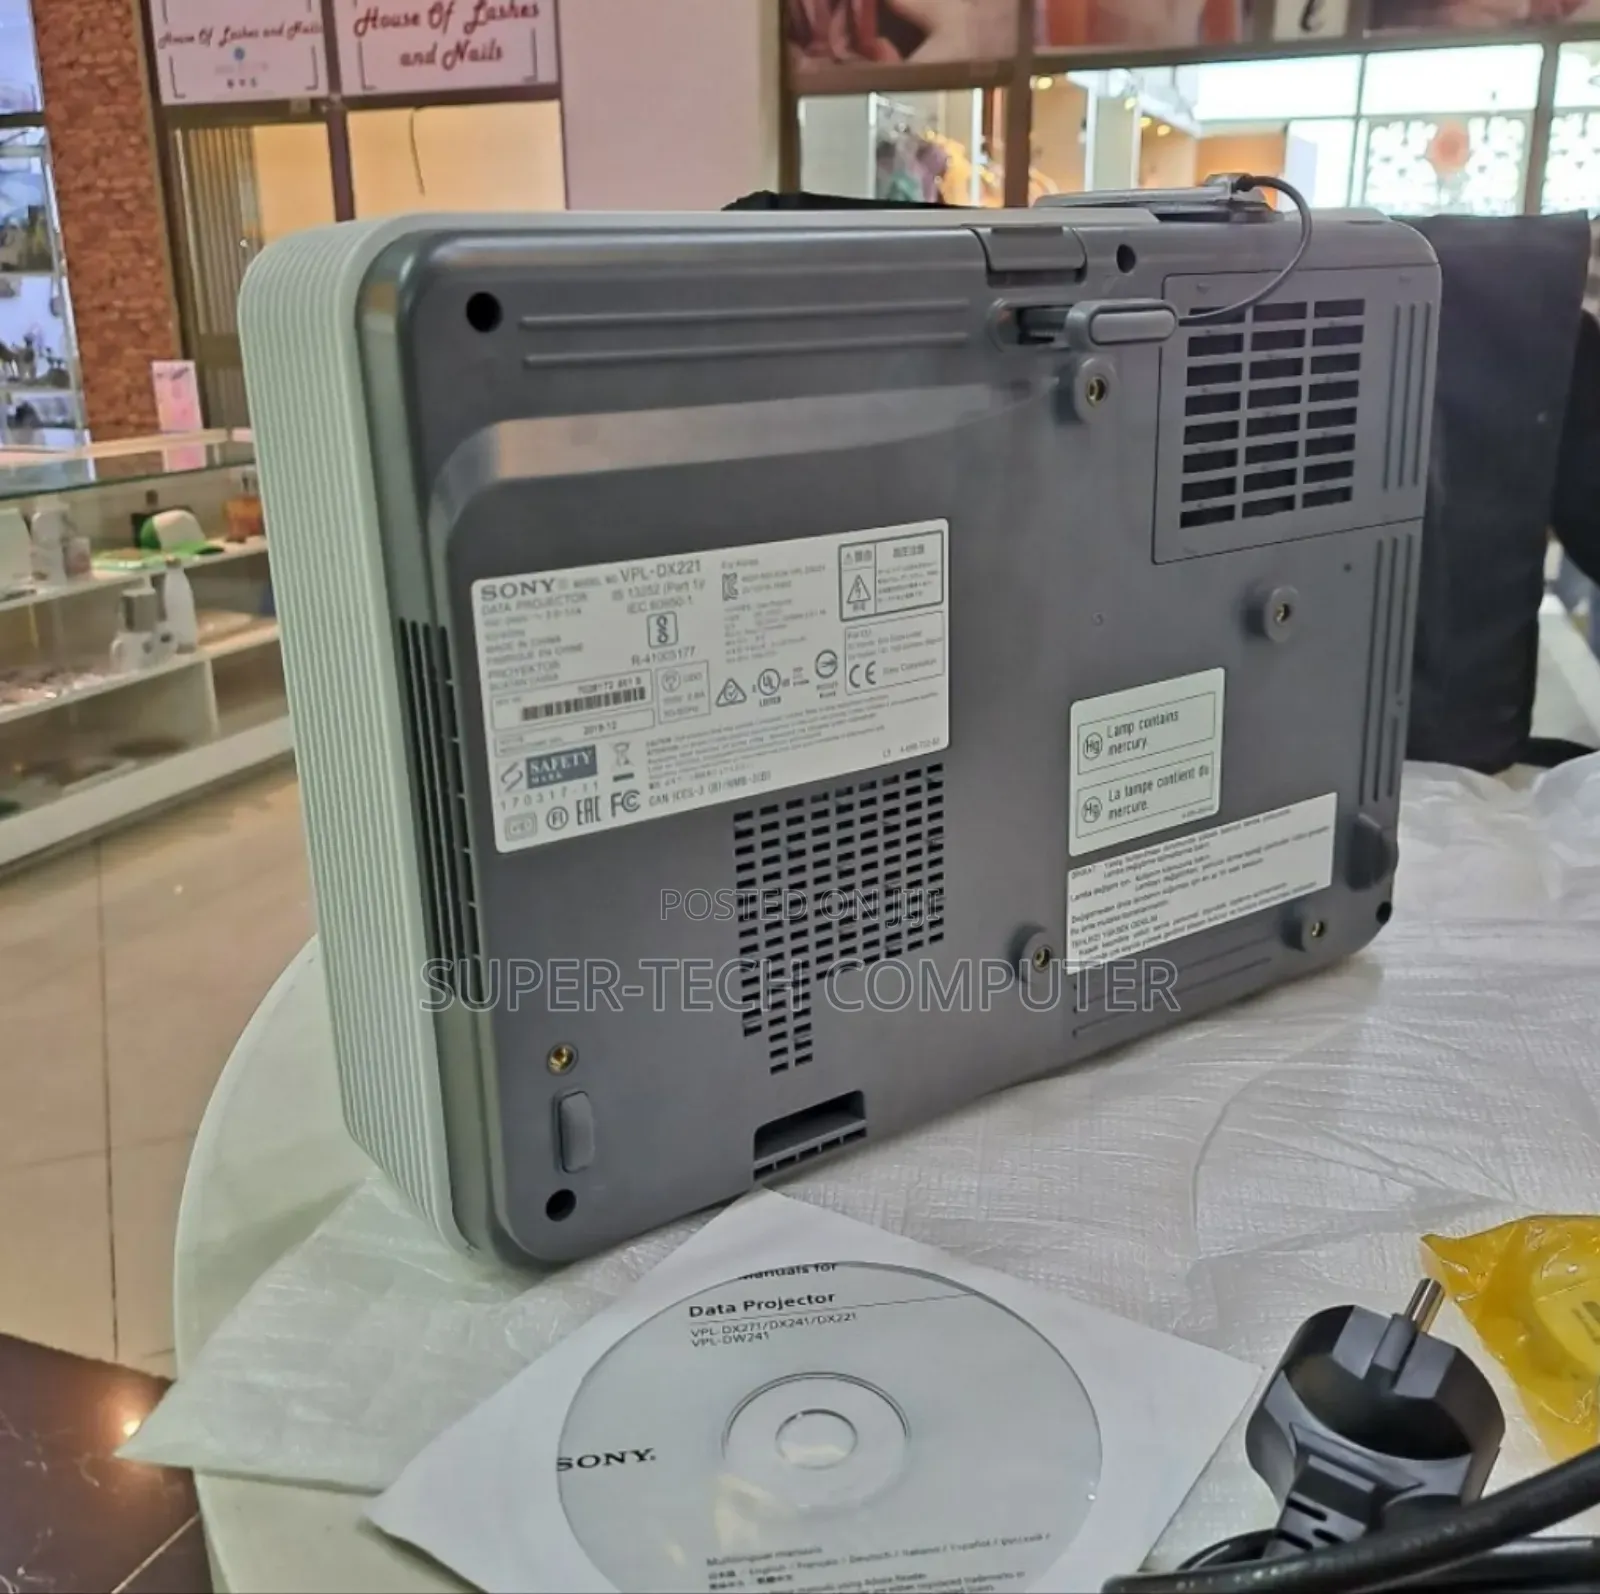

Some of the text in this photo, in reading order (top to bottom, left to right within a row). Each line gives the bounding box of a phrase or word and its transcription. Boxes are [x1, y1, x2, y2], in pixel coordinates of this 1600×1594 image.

[354, 0, 540, 37] House Of Lashes
[158, 31, 195, 49] House
[218, 25, 259, 47] Lashes
[263, 21, 285, 38] and
[400, 38, 503, 71] and Nails
[480, 578, 554, 601] SONY
[620, 559, 701, 583] VPL-DX221
[481, 602, 511, 616] DATA
[1107, 710, 1179, 738] Lamp contains
[1108, 737, 1148, 756] mercury
[529, 750, 593, 775] SAFETY
[1108, 789, 1120, 802] La
[1125, 779, 1153, 797] lampe
[1157, 767, 1195, 788] contient
[689, 1293, 836, 1318] Data Projector
[691, 1331, 770, 1347] VPL-DW241
